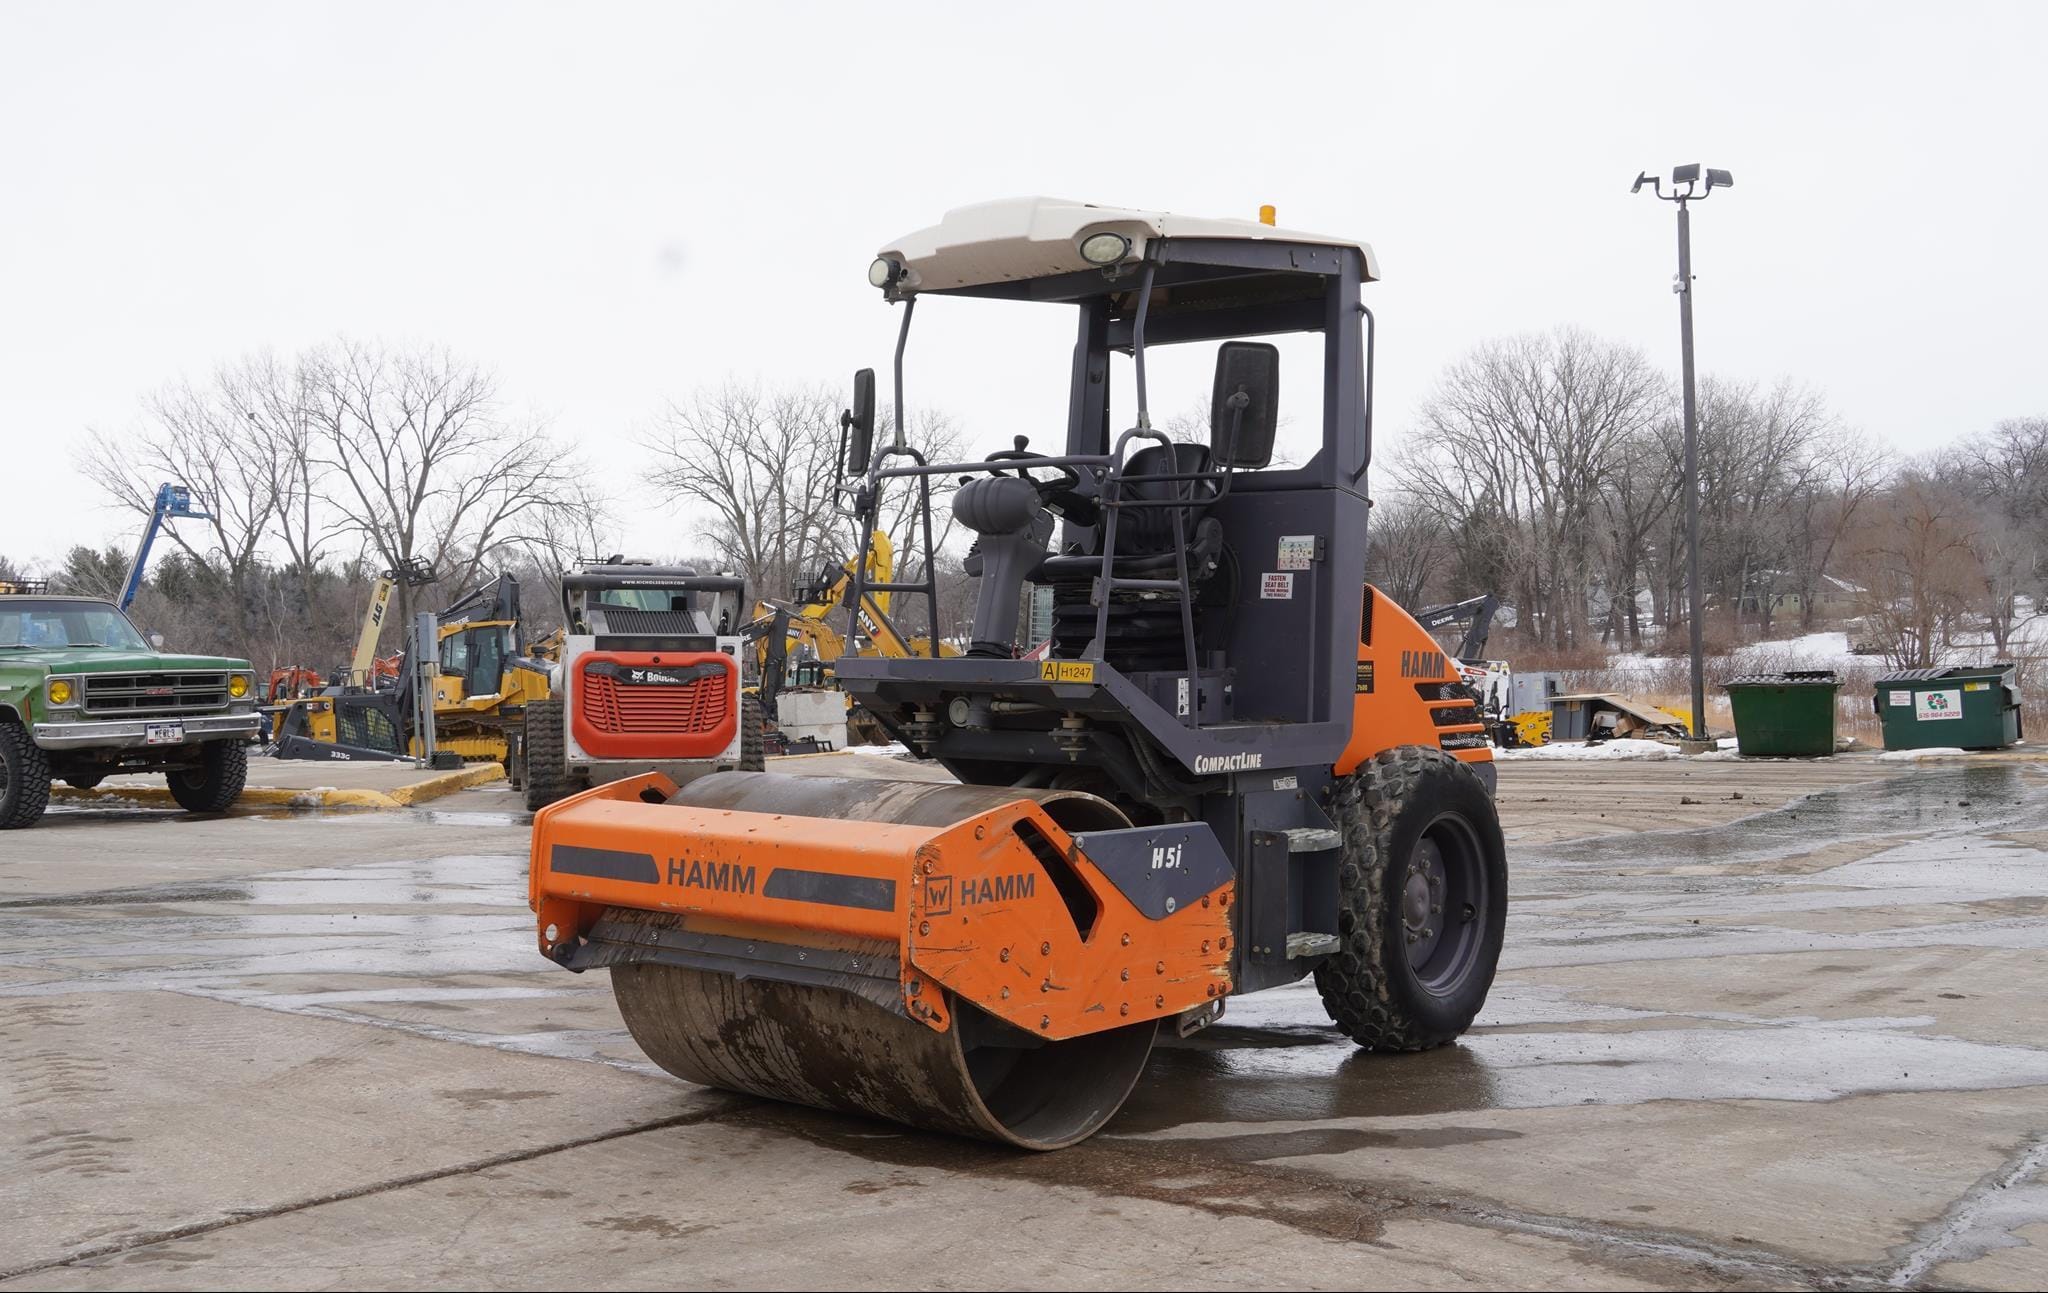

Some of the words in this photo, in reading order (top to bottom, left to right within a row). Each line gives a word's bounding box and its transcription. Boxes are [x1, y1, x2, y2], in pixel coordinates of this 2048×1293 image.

[372, 602, 384, 627] JLG
[858, 606, 879, 632] ANY
[1431, 615, 1455, 626] DEERE
[1043, 663, 1055, 680] A
[1061, 666, 1091, 678] H1247
[1401, 650, 1445, 678] HAMM
[330, 750, 351, 760] 333G
[667, 857, 756, 896] HAMM
[961, 872, 1036, 906] HAMM
